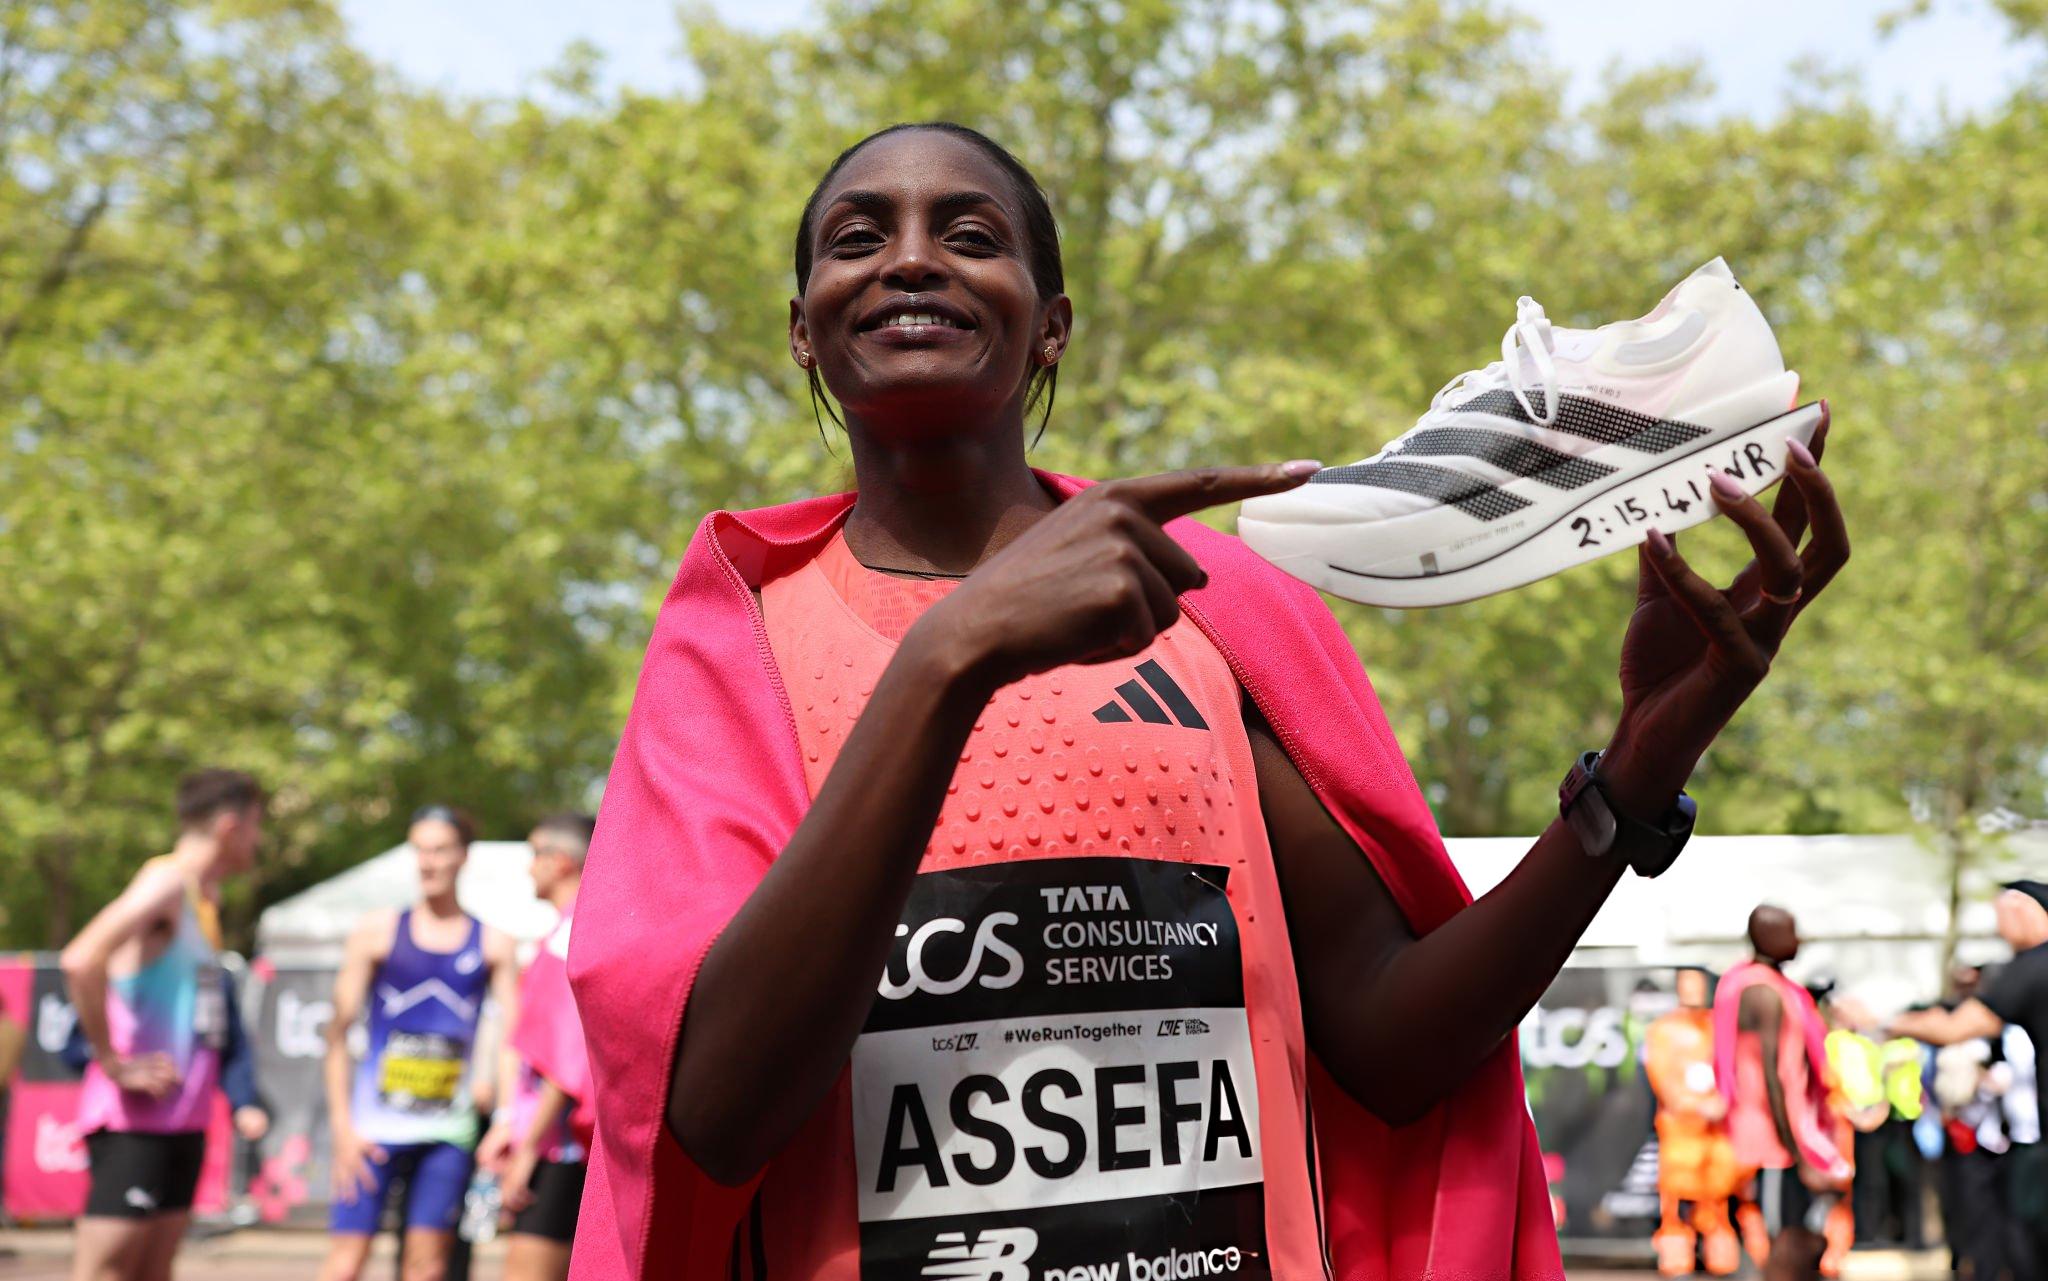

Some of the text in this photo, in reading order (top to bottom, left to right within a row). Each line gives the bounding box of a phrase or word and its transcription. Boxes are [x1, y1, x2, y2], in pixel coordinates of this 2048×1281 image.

[1570, 480, 1702, 548] 2:15.41
[1040, 885, 1131, 914] TATA
[1042, 920, 1219, 950] CONSULTANCY
[1045, 954, 1173, 986] SERVICES
[1003, 1022, 1142, 1044] #WeRunTogether
[875, 1058, 1253, 1194] ASSEFA
[1126, 1246, 1242, 1281] balance
